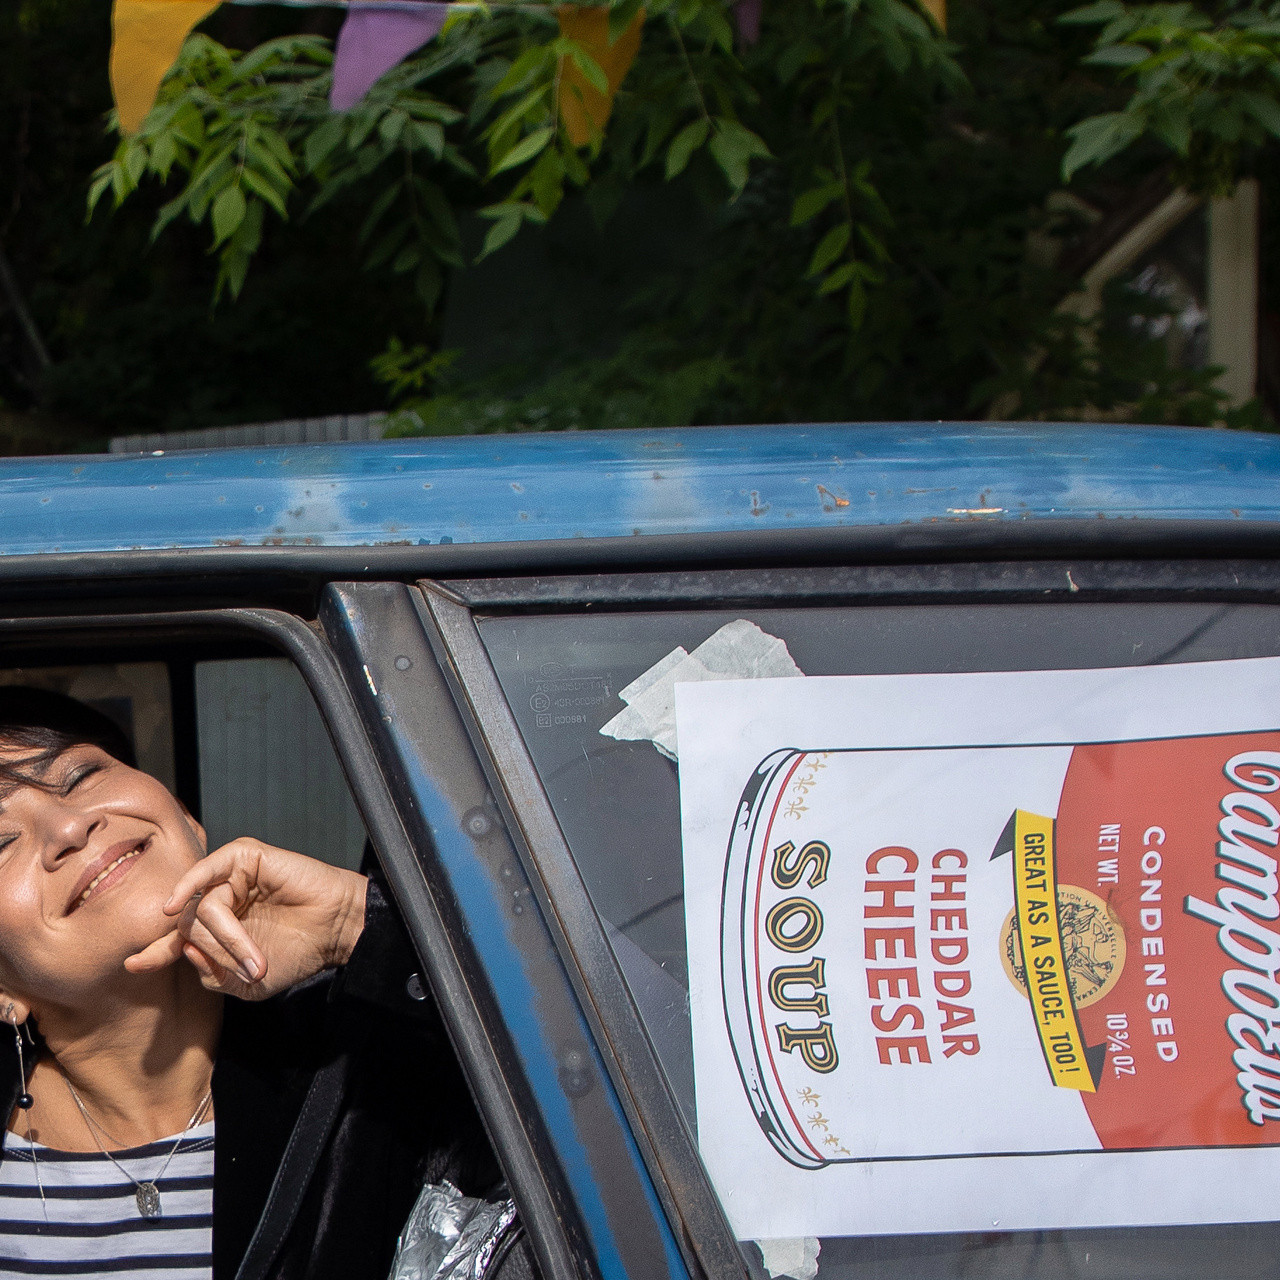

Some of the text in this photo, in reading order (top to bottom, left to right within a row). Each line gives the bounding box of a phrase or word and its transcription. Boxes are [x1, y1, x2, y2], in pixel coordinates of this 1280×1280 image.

[765, 839, 840, 1074] SOUP
[864, 846, 932, 1066] CHEESE
[930, 848, 981, 1059] CHEDDAR
[1023, 832, 1081, 1073] GREAT AS A SAUCE, TOO!
[1097, 823, 1121, 887] NET WT.
[1140, 825, 1179, 1062] CONDENSED
[1112, 1055, 1137, 1079] OZ.
